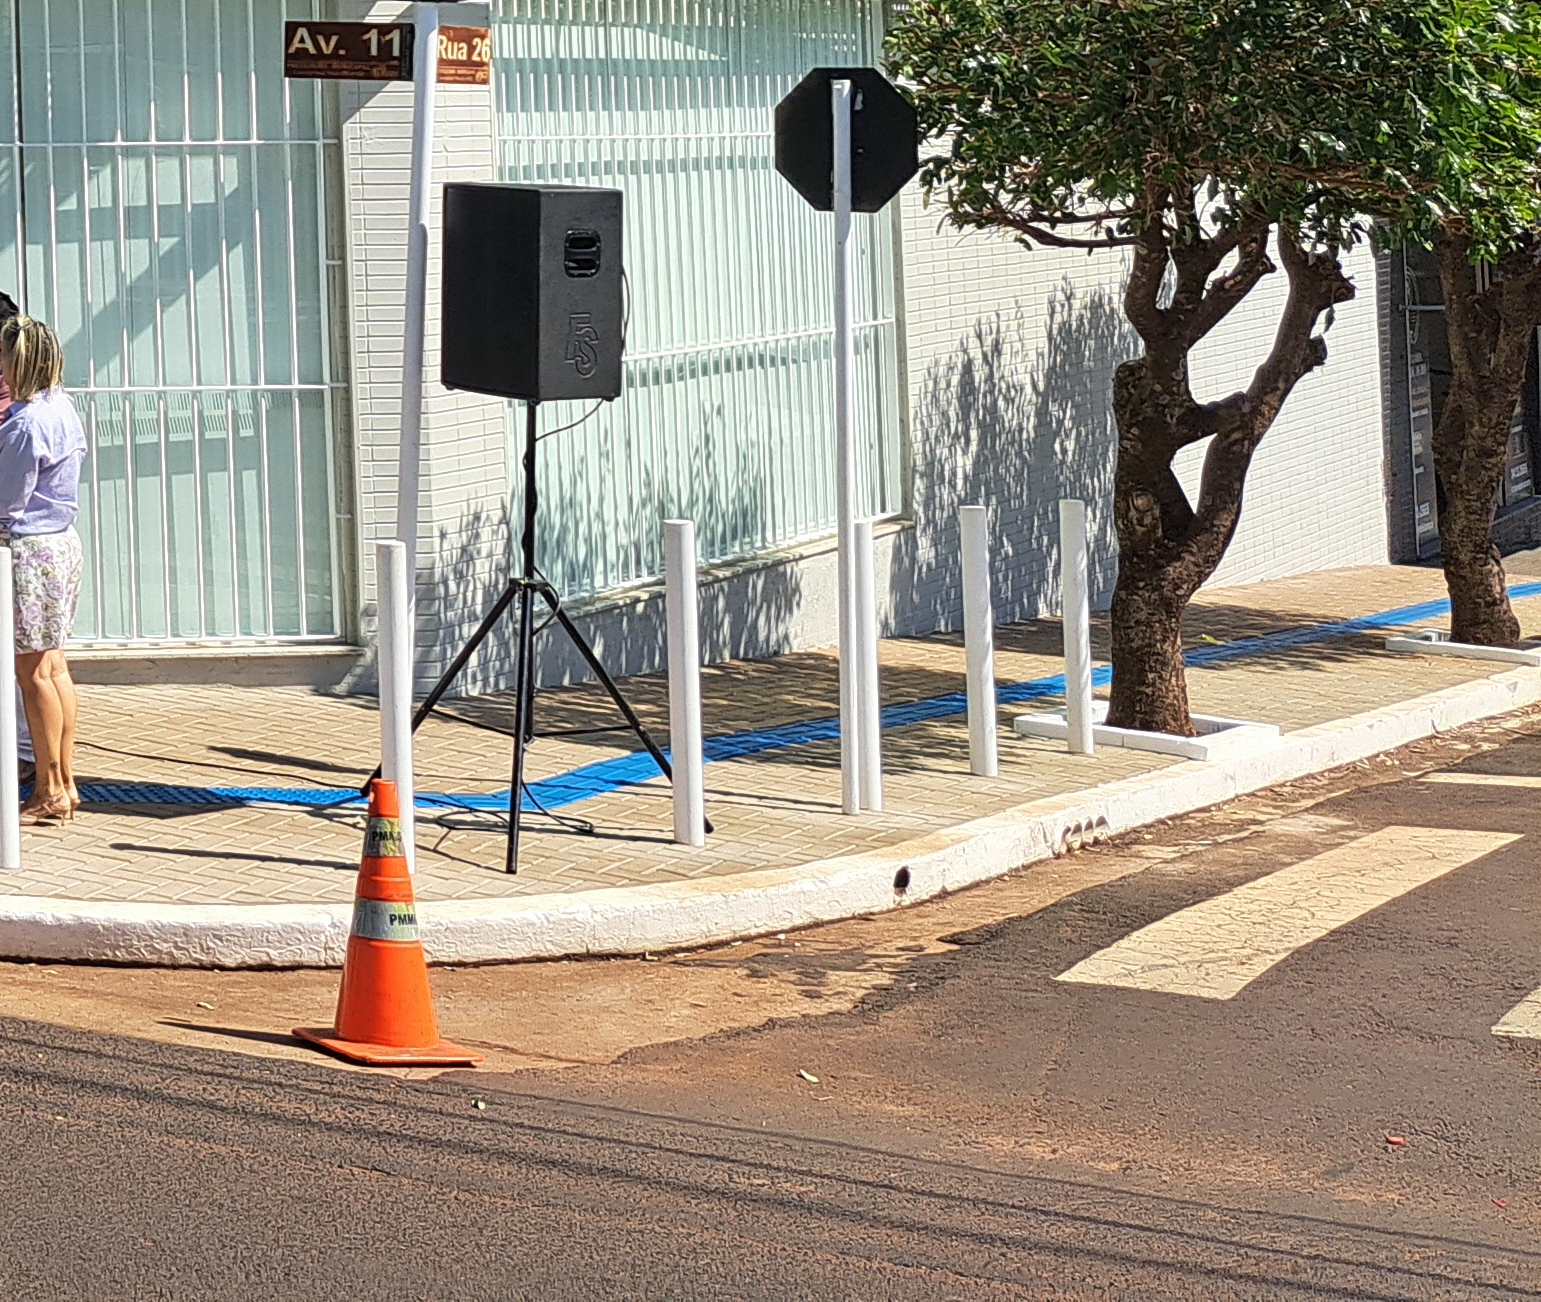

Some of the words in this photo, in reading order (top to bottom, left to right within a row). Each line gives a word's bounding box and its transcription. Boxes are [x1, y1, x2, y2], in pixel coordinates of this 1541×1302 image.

[288, 27, 346, 55] Av.
[362, 28, 401, 57] 11
[437, 35, 467, 60] Rua
[472, 38, 491, 63] 26
